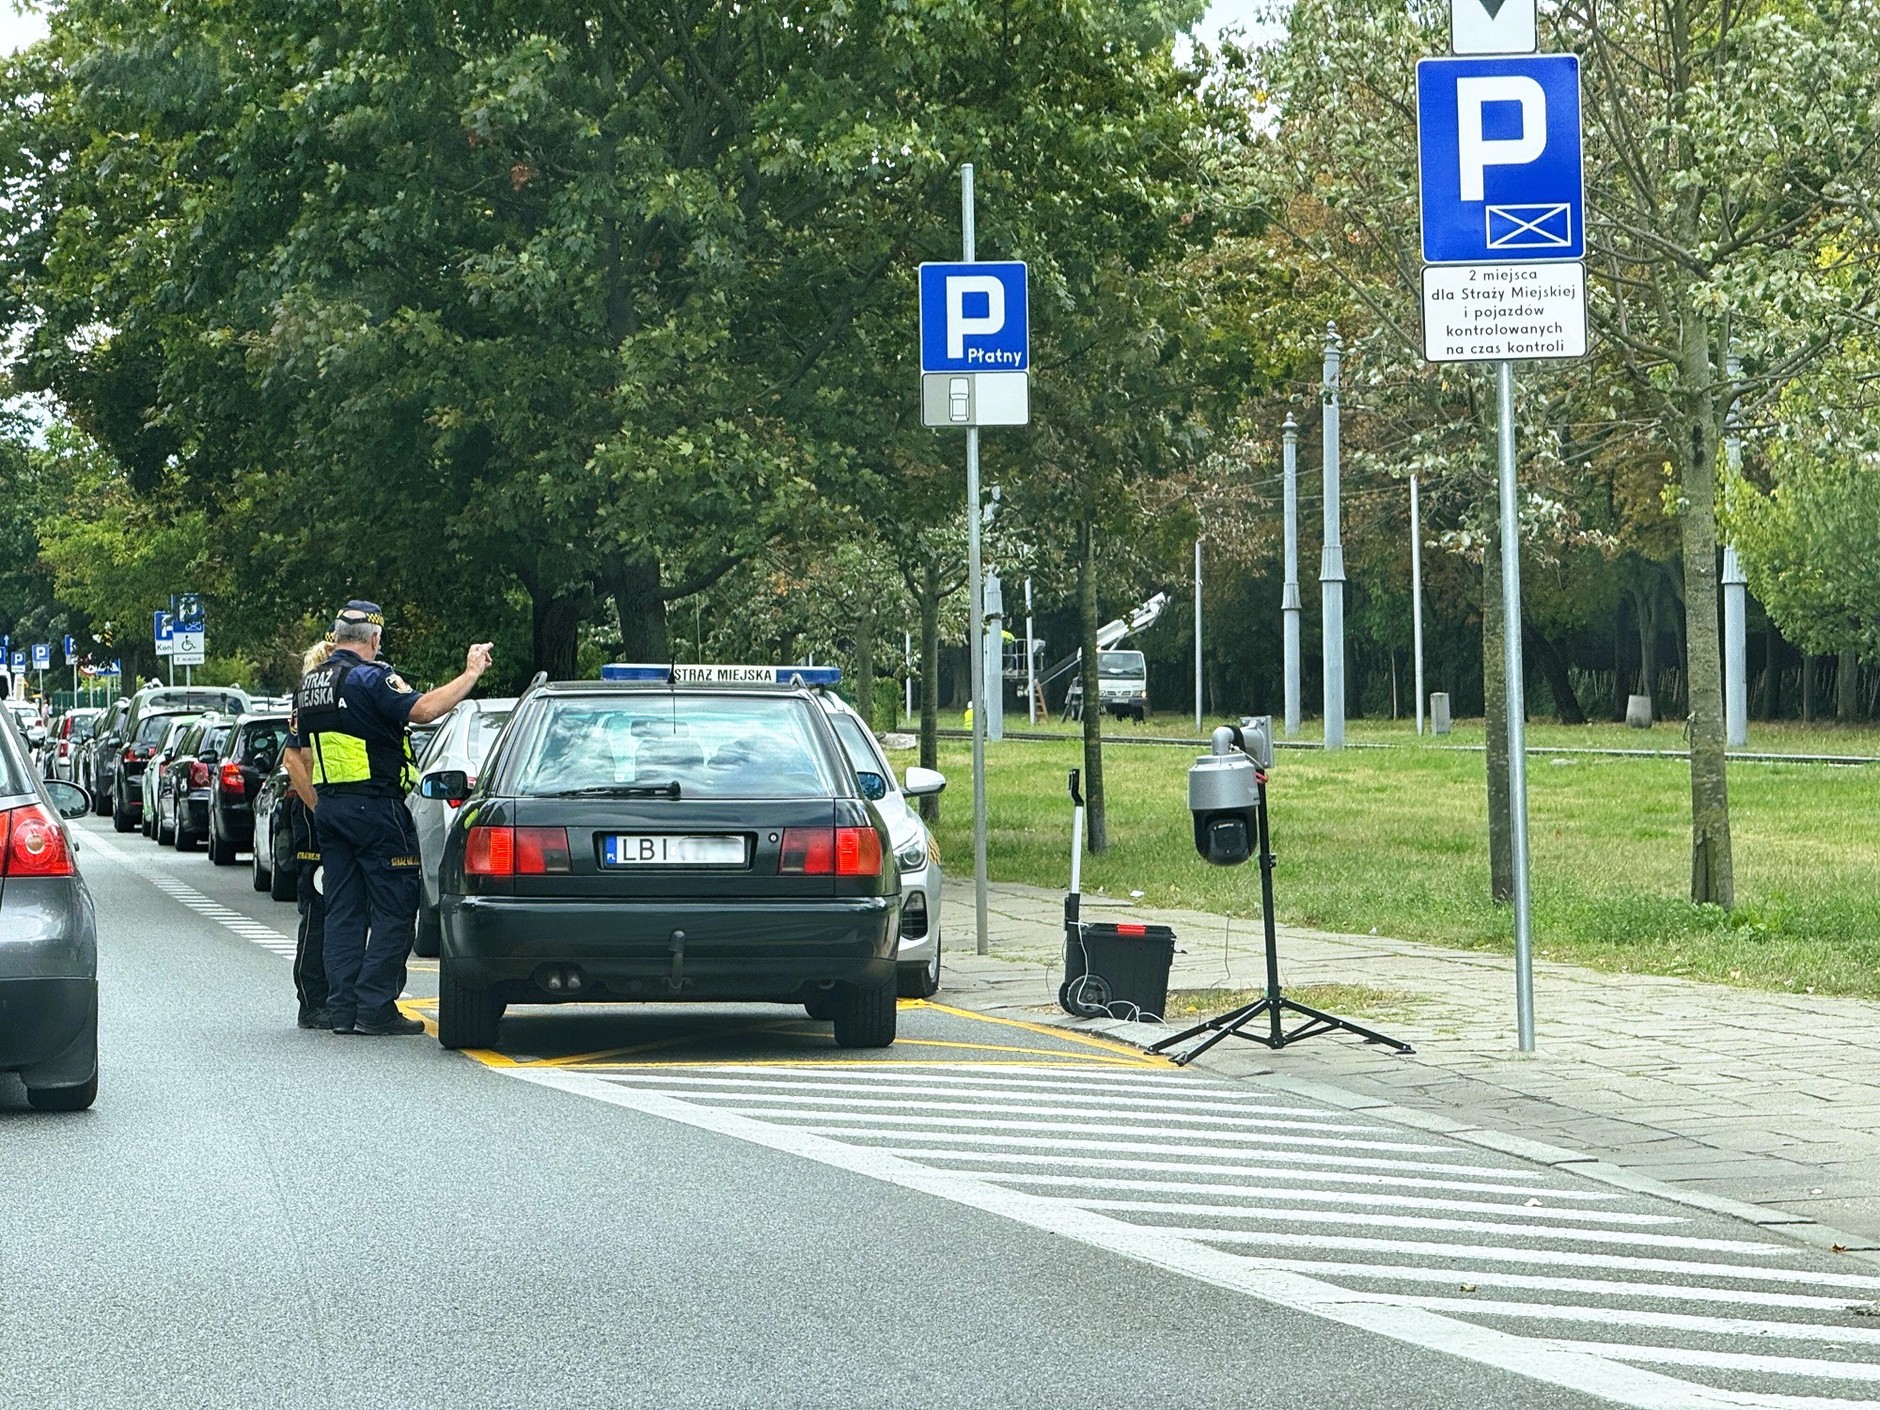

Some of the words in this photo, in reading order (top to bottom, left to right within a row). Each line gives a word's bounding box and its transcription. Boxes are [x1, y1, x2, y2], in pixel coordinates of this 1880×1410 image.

[1456, 75, 1547, 202] P
[1469, 269, 1477, 281] 2
[1483, 268, 1538, 283] miejsca
[1431, 288, 1455, 301] dla
[1461, 286, 1505, 302] Straży
[1511, 284, 1576, 300] Miejskiej
[946, 275, 1006, 359] P
[1464, 305, 1468, 318] i
[1474, 303, 1545, 321] pojazdów
[1446, 321, 1563, 337] kontrolowanych
[1446, 344, 1464, 355] na
[1470, 344, 1501, 354] czas
[1507, 339, 1564, 353] kontroli
[968, 347, 1022, 367] Płatny
[15, 653, 23, 665] P
[36, 646, 46, 660] P
[302, 668, 334, 690] STRAŻ
[717, 669, 772, 681] MIEJSKA
